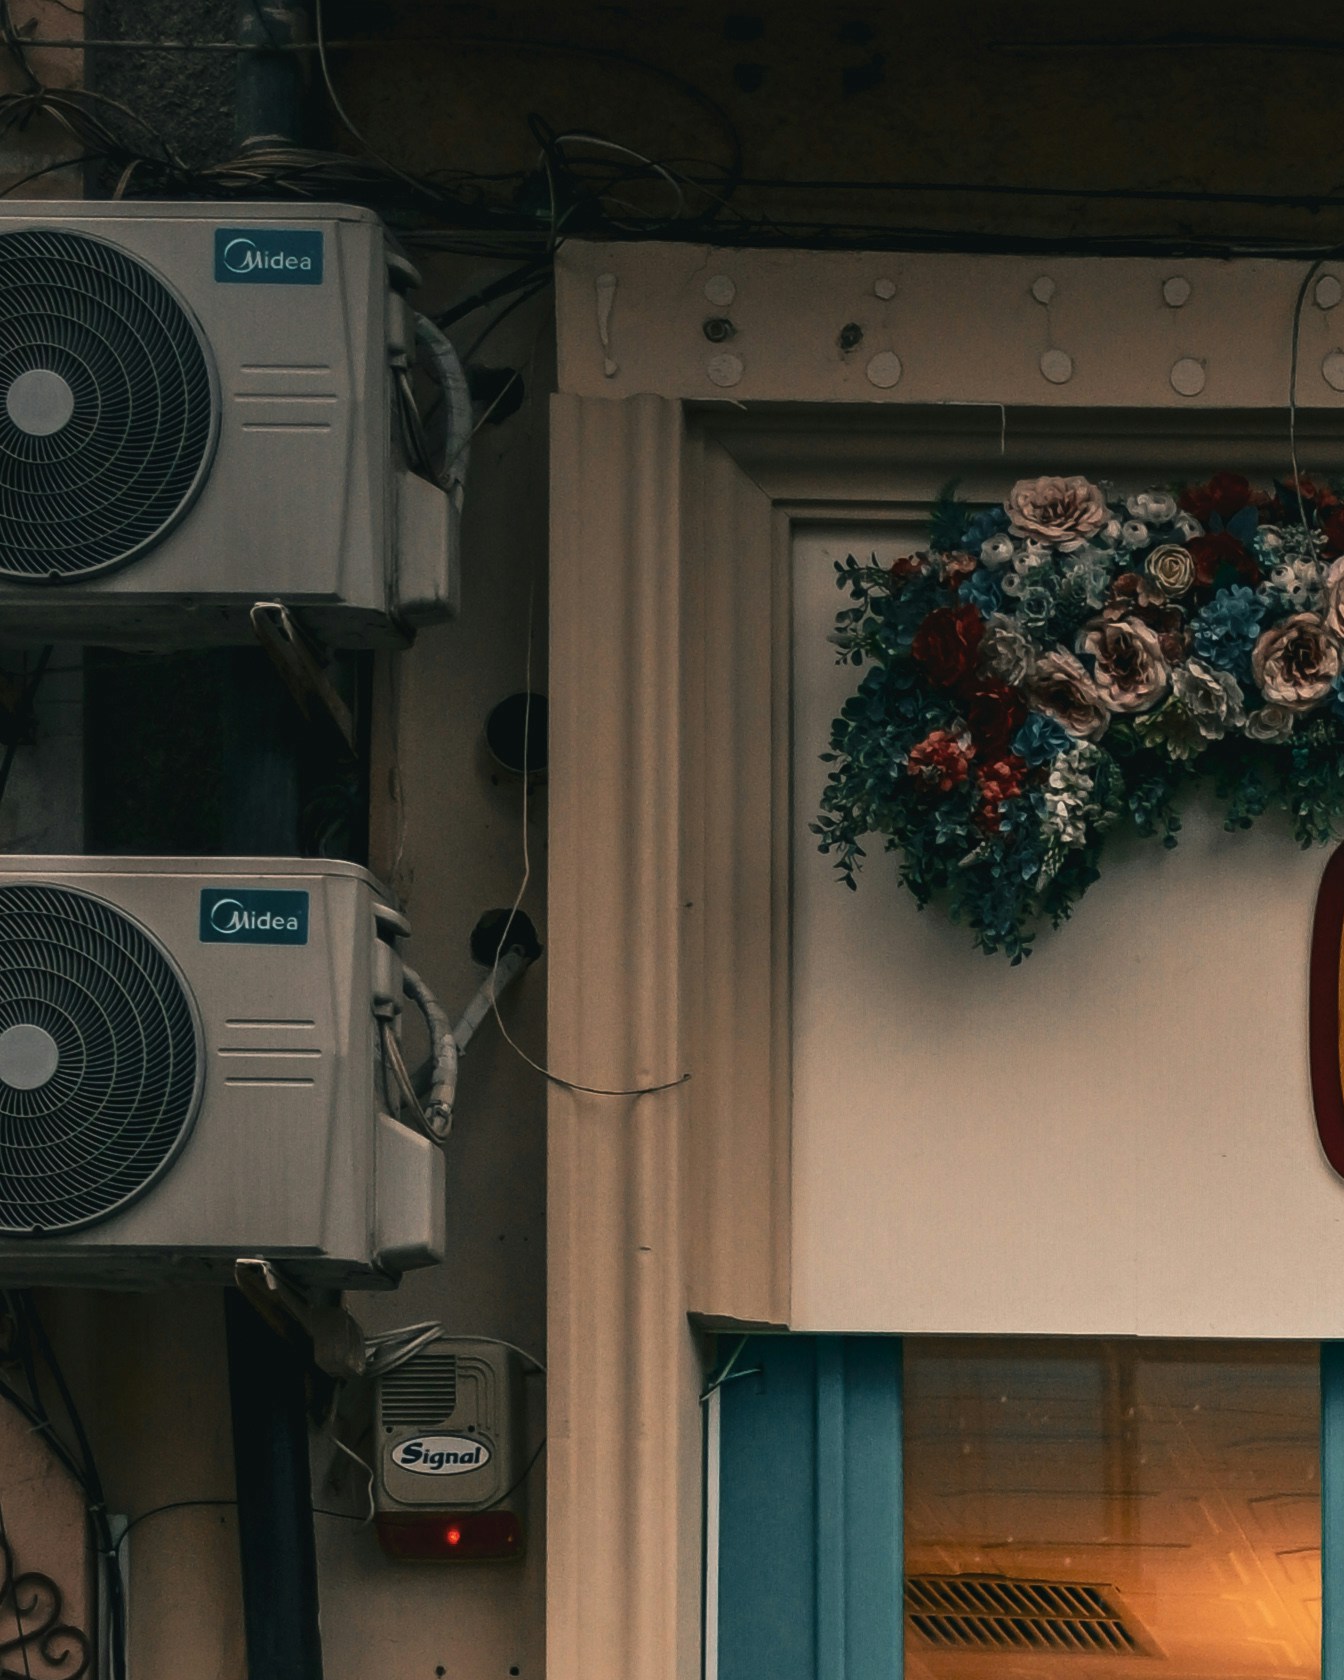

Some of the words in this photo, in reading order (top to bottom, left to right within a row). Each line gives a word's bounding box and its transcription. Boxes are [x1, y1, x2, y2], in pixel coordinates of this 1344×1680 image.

[230, 246, 312, 271] Midea
[218, 905, 299, 933] Midea
[401, 1442, 481, 1470] Signal
